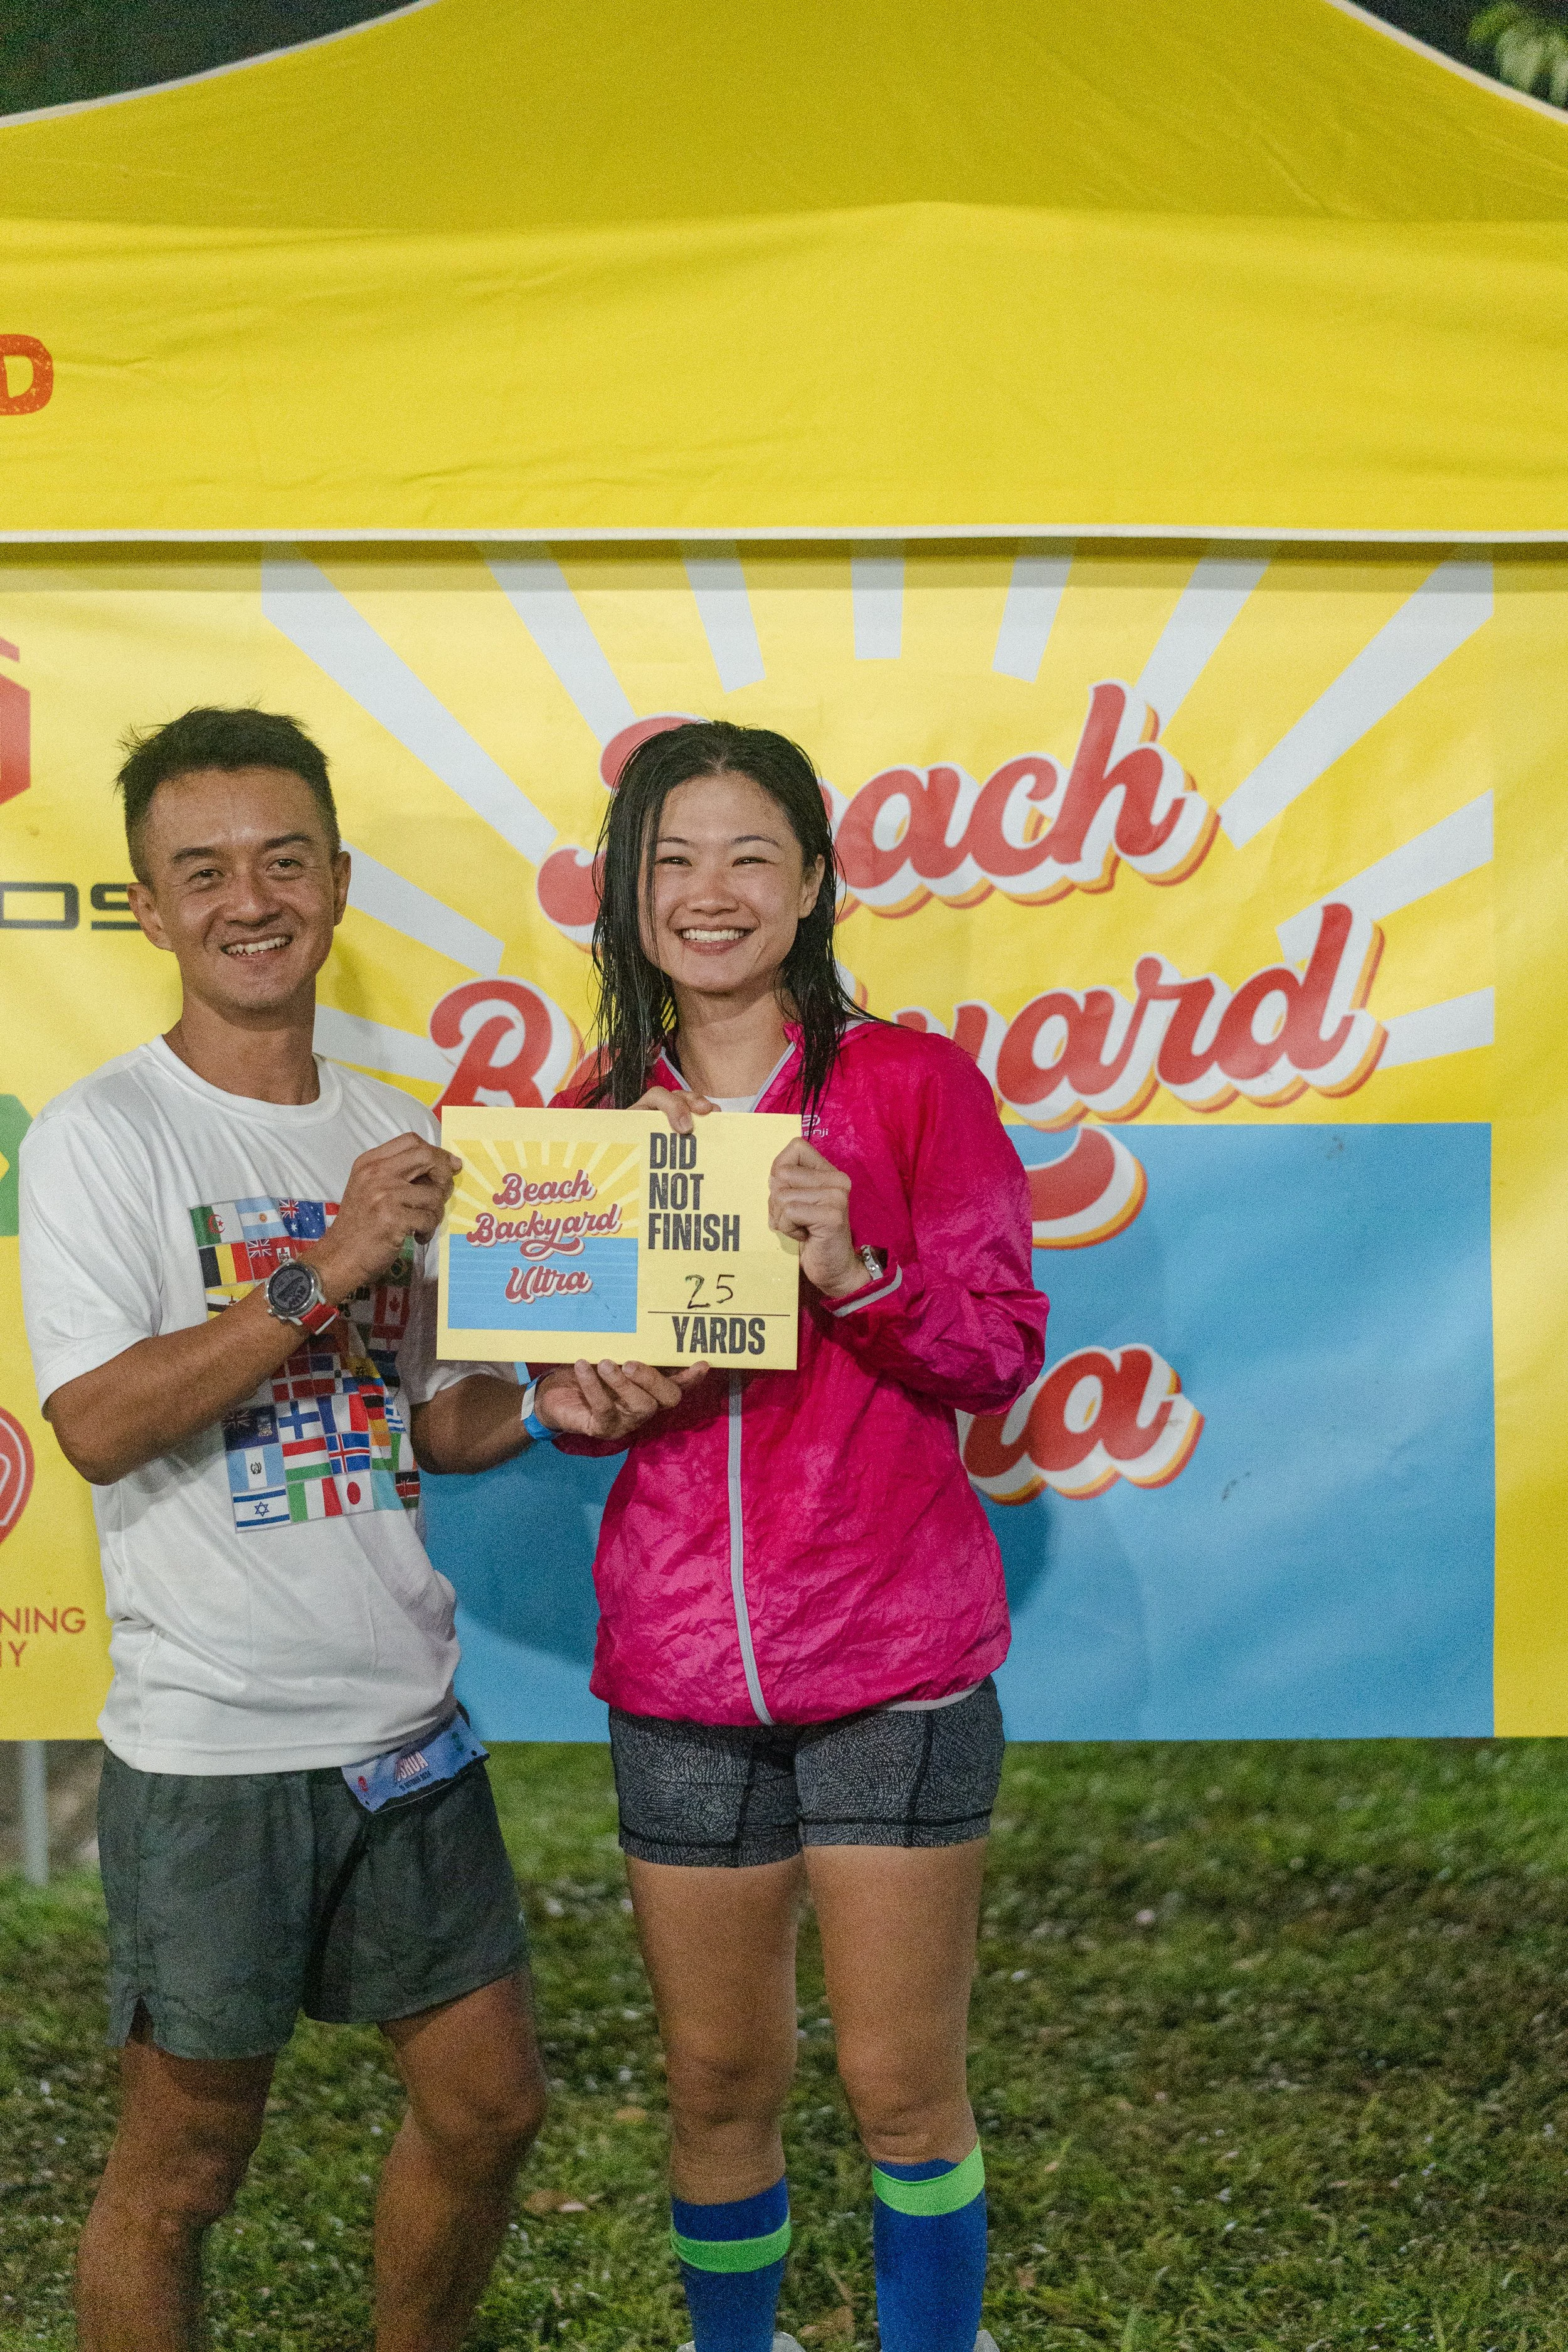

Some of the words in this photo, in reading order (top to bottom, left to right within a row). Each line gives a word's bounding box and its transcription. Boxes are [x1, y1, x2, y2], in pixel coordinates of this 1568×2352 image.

[537, 680, 1221, 955] ach
[650, 1132, 697, 1170] DID
[492, 1169, 597, 1210] Beach
[649, 1173, 704, 1210] NOT
[466, 1204, 622, 1261] Backyard
[648, 1212, 740, 1251] FINISH
[505, 1265, 593, 1304] Ultra
[685, 1274, 735, 1309] 25
[671, 1316, 765, 1355] YARDS
